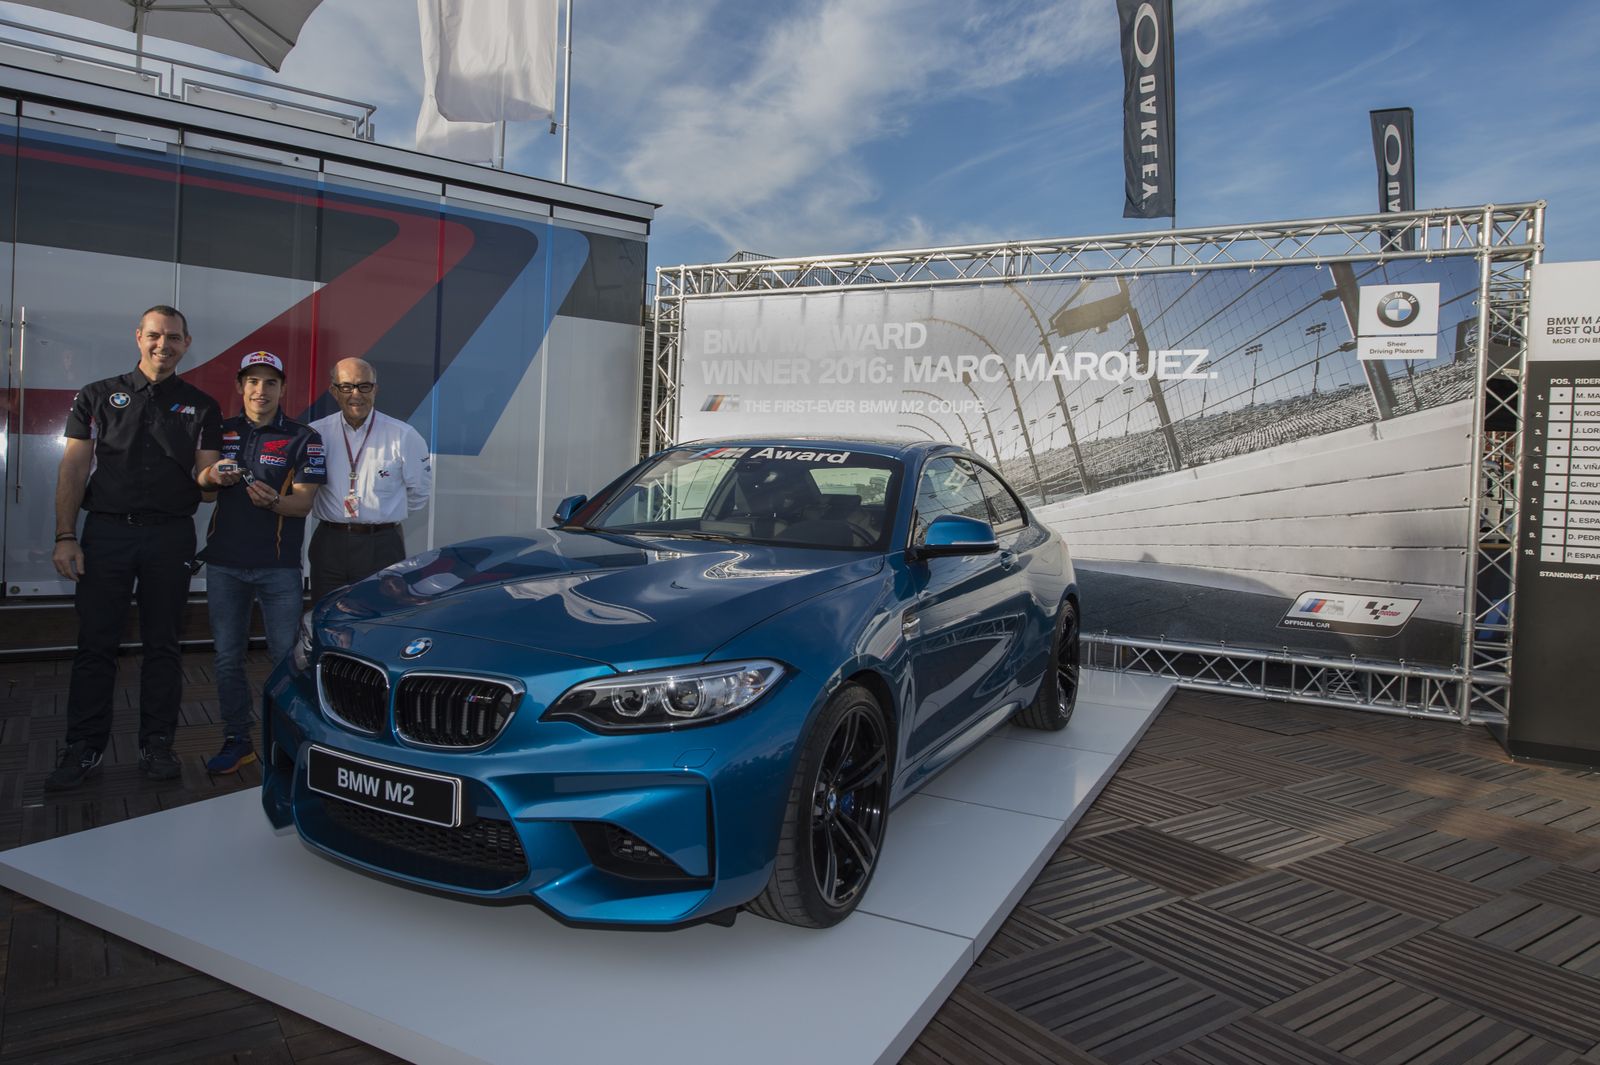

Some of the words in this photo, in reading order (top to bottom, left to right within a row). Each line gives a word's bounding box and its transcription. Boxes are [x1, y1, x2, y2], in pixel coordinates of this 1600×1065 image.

[1547, 317, 1579, 326] BMW
[1581, 316, 1592, 325] M
[1546, 326, 1580, 335] BEST
[703, 328, 768, 354] BMW
[701, 357, 812, 385] WINNER
[818, 356, 893, 384] 2016:
[903, 354, 1002, 383] MARC
[1015, 346, 1218, 383] MÁRQUEZ.
[744, 401, 771, 413] THE
[774, 400, 855, 413] FIRST-EVER
[859, 400, 898, 413] BMW
[901, 400, 924, 413] M2
[750, 447, 850, 464] Award
[1539, 571, 1583, 579] STANDINGS
[1284, 619, 1315, 628] OFFICIAL
[337, 767, 380, 798] BMW
[385, 780, 415, 806] M2
